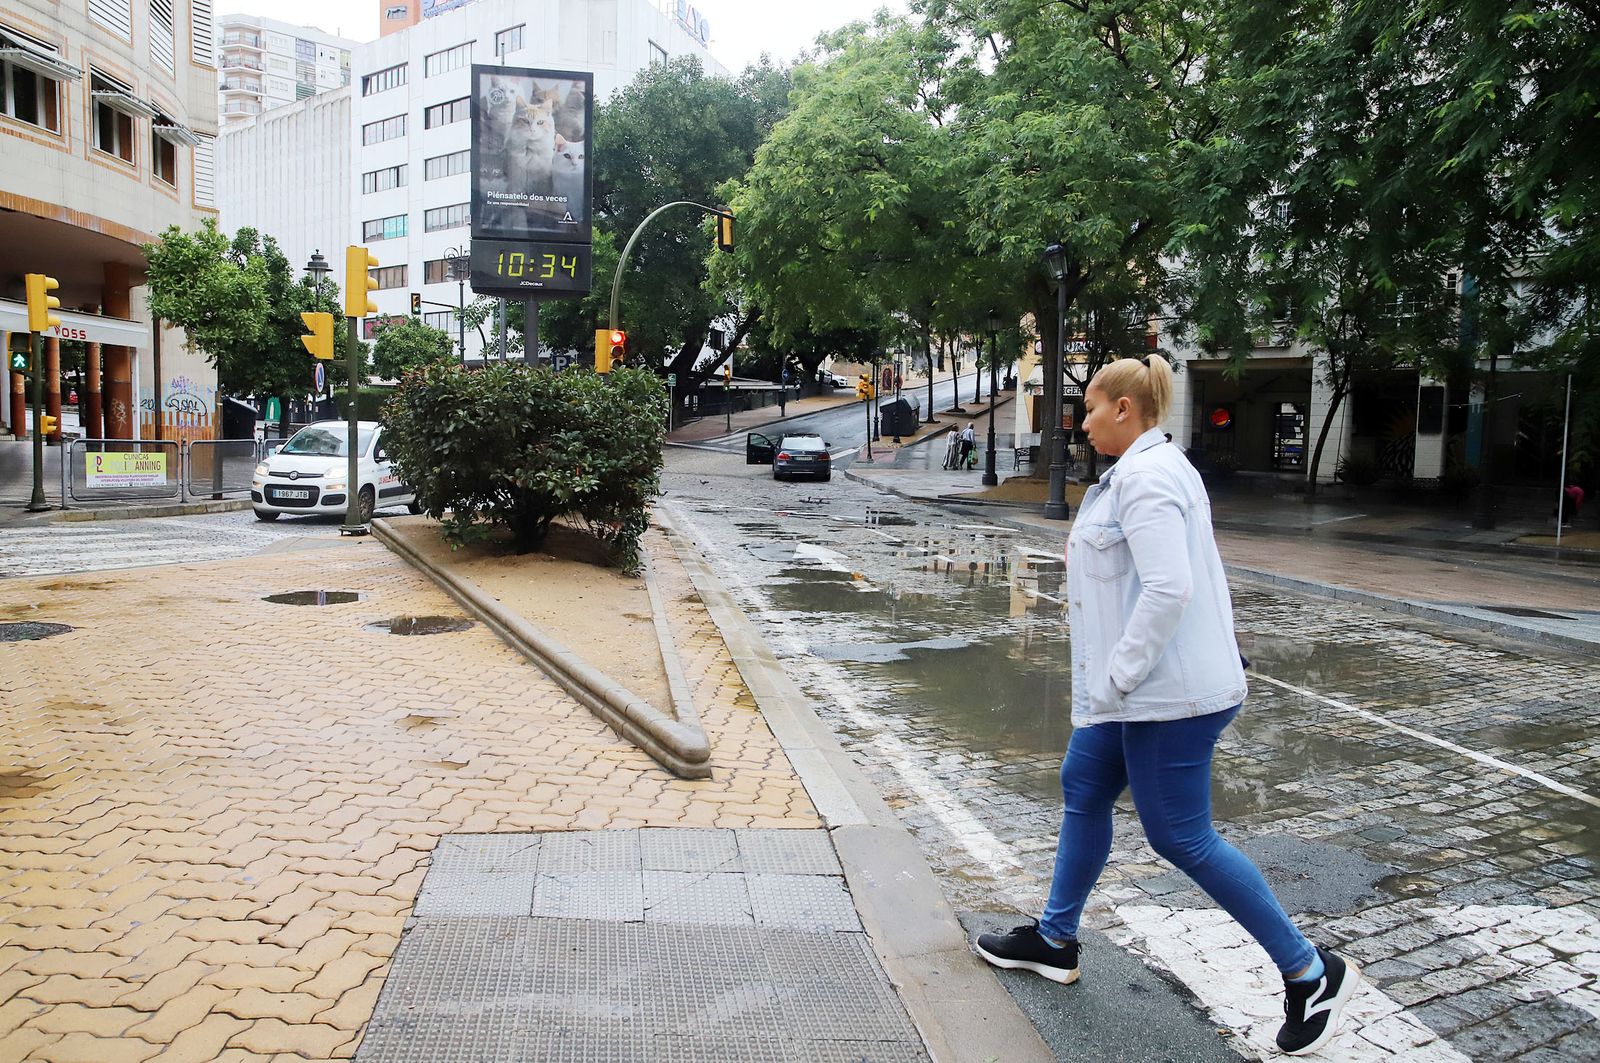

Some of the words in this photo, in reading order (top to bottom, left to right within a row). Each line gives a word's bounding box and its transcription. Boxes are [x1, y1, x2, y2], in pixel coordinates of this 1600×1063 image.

[487, 190, 528, 201] Piénsatelo
[529, 193, 544, 202] dos
[545, 194, 568, 203] veces
[497, 252, 577, 279] 10:34
[278, 490, 293, 498] 1967
